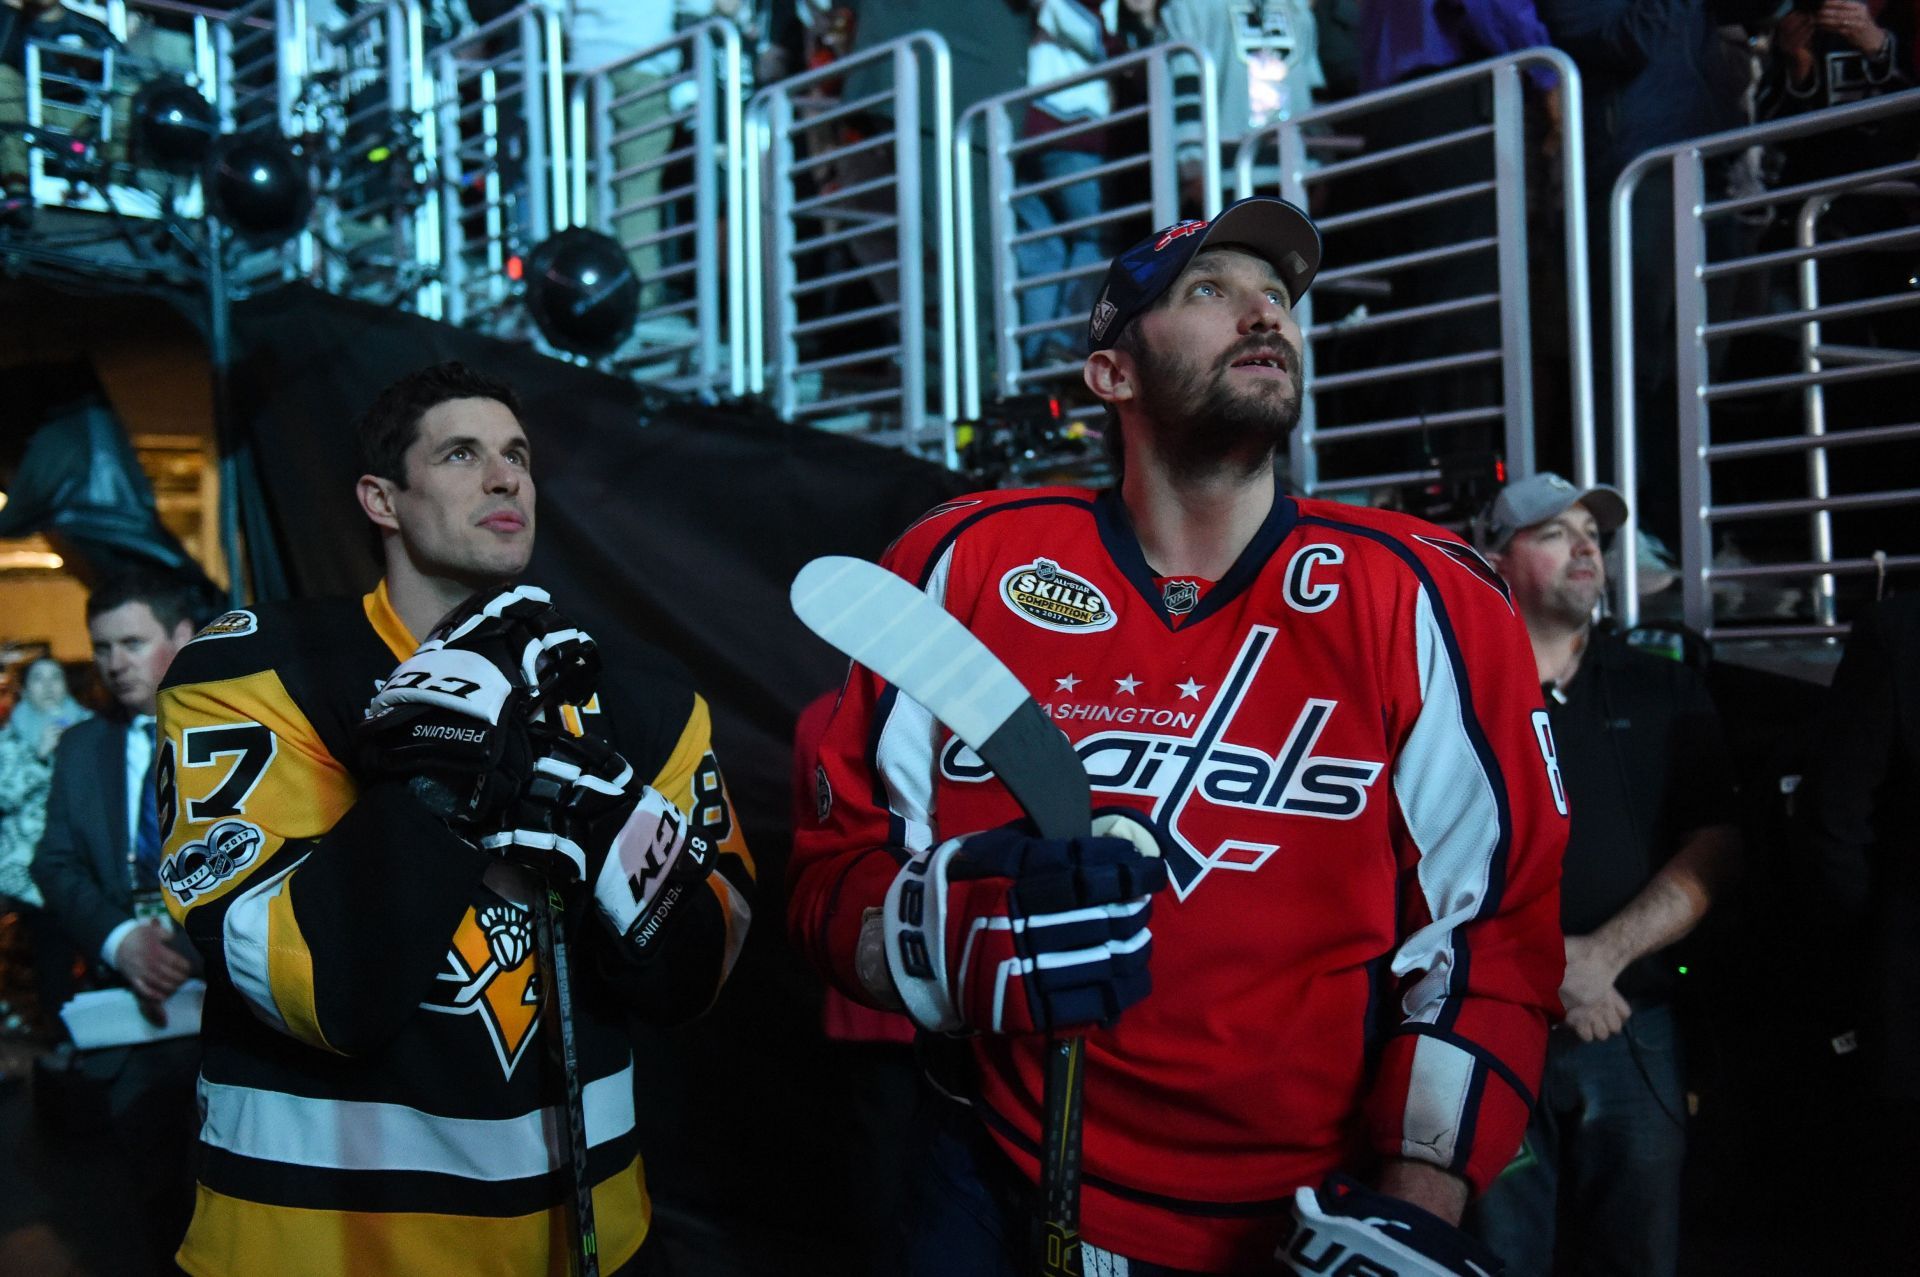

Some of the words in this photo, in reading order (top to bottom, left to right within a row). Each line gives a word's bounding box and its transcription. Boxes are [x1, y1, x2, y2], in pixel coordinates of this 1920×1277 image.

[1282, 543, 1345, 614] C
[1018, 574, 1101, 613] SKILLS
[1017, 594, 1090, 621] COMPETITION
[1042, 610, 1063, 621] 2017
[383, 671, 481, 699] CC
[1040, 702, 1197, 729] ASHINGTON
[413, 725, 486, 743] PENGUINS
[224, 831, 250, 851] 2017
[688, 836, 708, 865] 87
[181, 869, 205, 888] 1917
